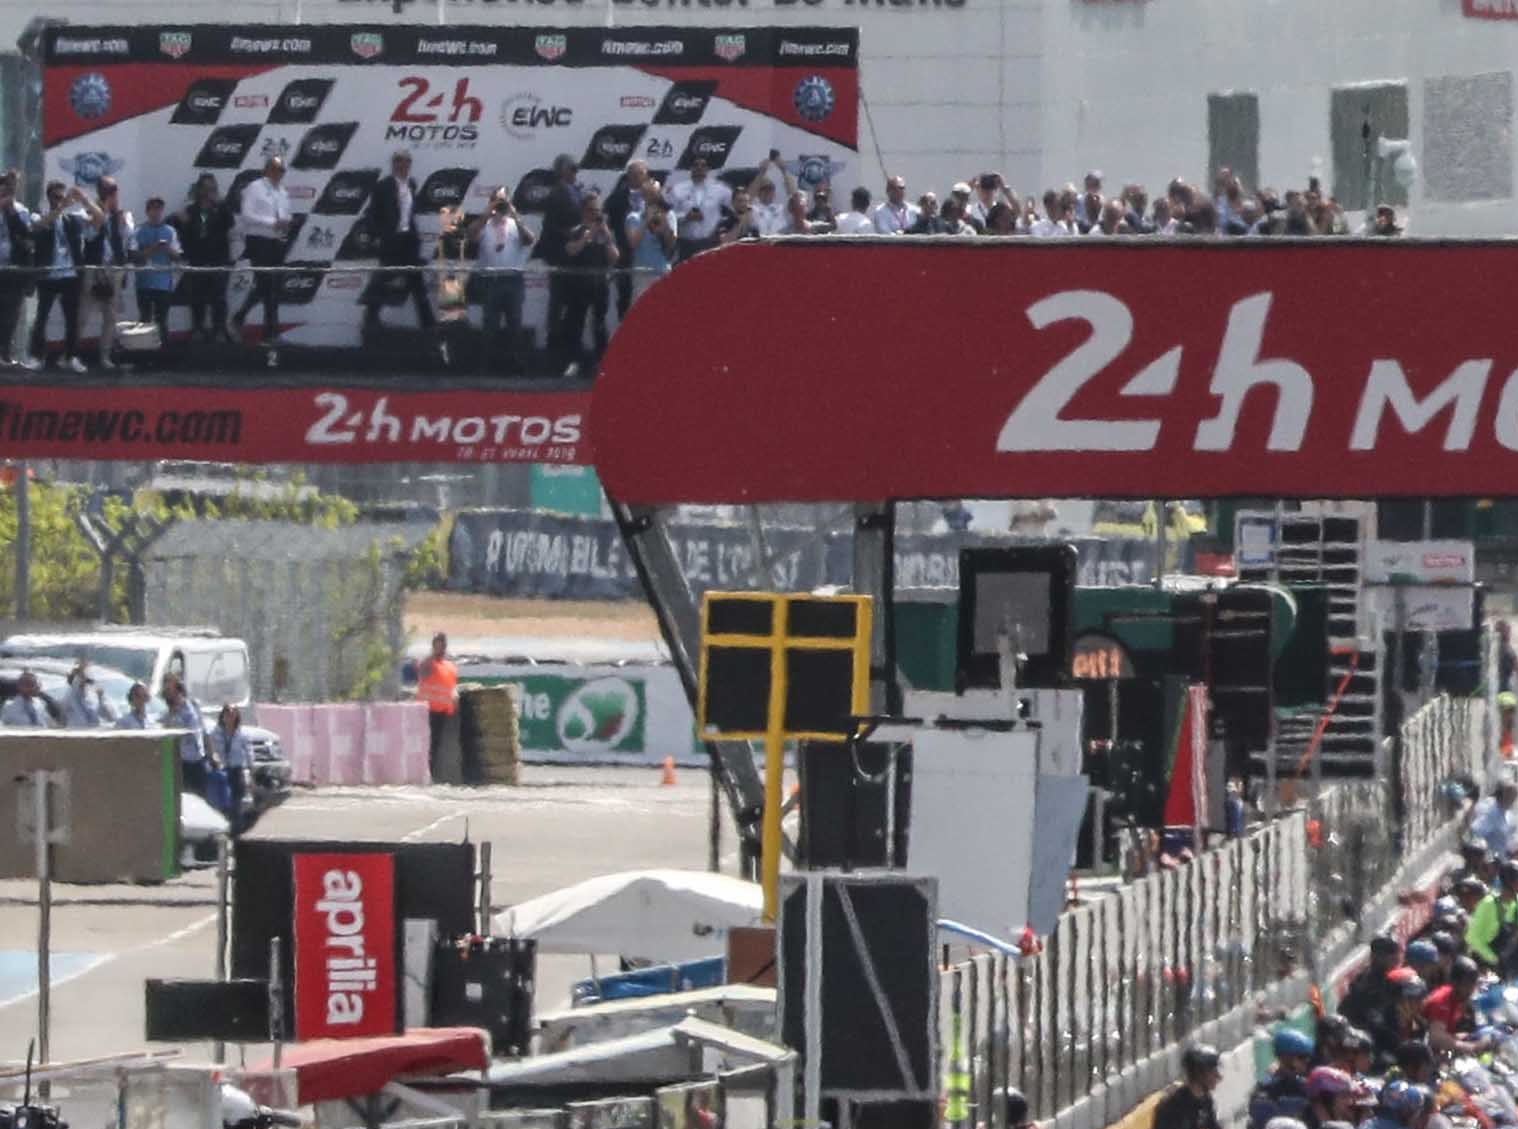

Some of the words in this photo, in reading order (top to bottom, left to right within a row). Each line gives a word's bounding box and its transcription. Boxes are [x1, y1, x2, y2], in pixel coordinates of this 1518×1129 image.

[512, 105, 573, 128] EWC
[384, 125, 480, 142] MOTOS
[411, 414, 582, 445] MOTOS
[316, 869, 377, 1026] aprilia
